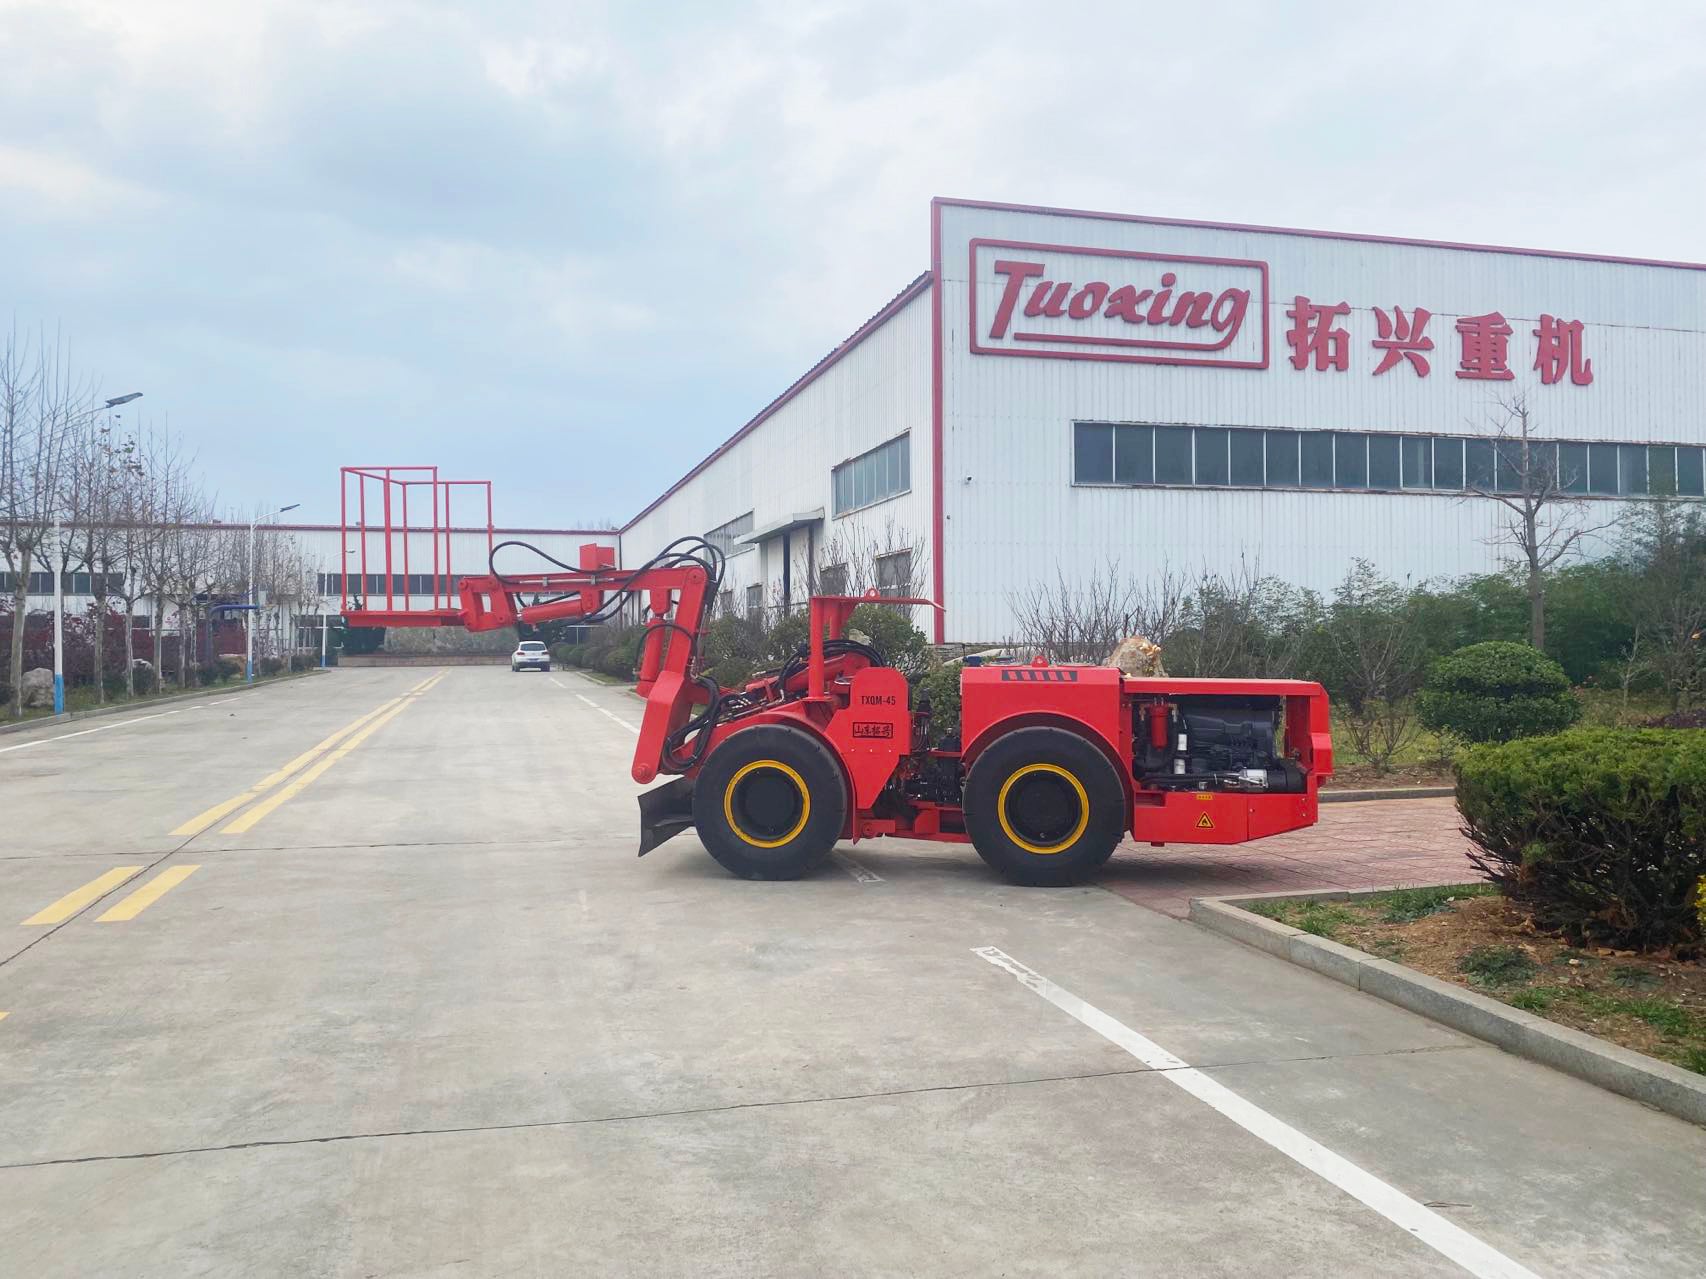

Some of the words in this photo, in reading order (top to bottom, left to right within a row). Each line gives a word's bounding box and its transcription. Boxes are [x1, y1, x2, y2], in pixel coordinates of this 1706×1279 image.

[988, 260, 1252, 350] Tuoxing
[1286, 296, 1593, 386] 拓兴重机
